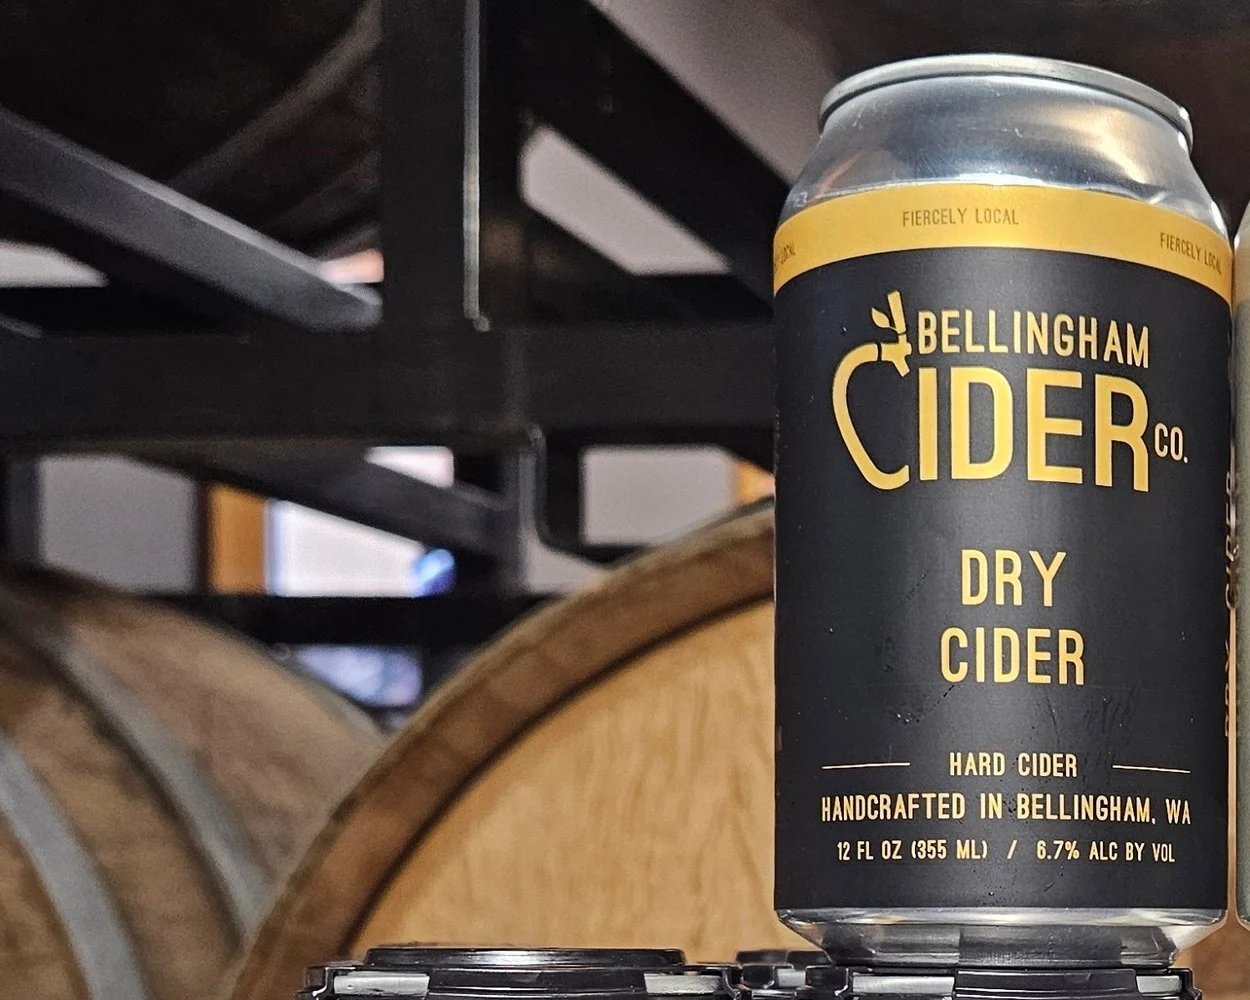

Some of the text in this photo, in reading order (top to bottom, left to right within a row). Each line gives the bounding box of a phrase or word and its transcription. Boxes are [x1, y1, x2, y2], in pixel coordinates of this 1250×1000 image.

[902, 208, 1019, 227] FIERCELY LOCAL
[1160, 231, 1201, 260] FIERCELY
[918, 309, 1149, 369] BELLINGHAM
[832, 366, 1188, 492] CIDER CO.
[961, 549, 1066, 607] DRY
[940, 627, 1085, 685] CIDER
[949, 752, 1077, 778] HARD CIDER
[821, 793, 966, 823] HANDCRAFTED
[980, 793, 1002, 820] IN
[1166, 798, 1191, 825] WA
[837, 839, 1175, 863] 12 FL OZ (355 ML) / 6.7% ALC BY VOL
